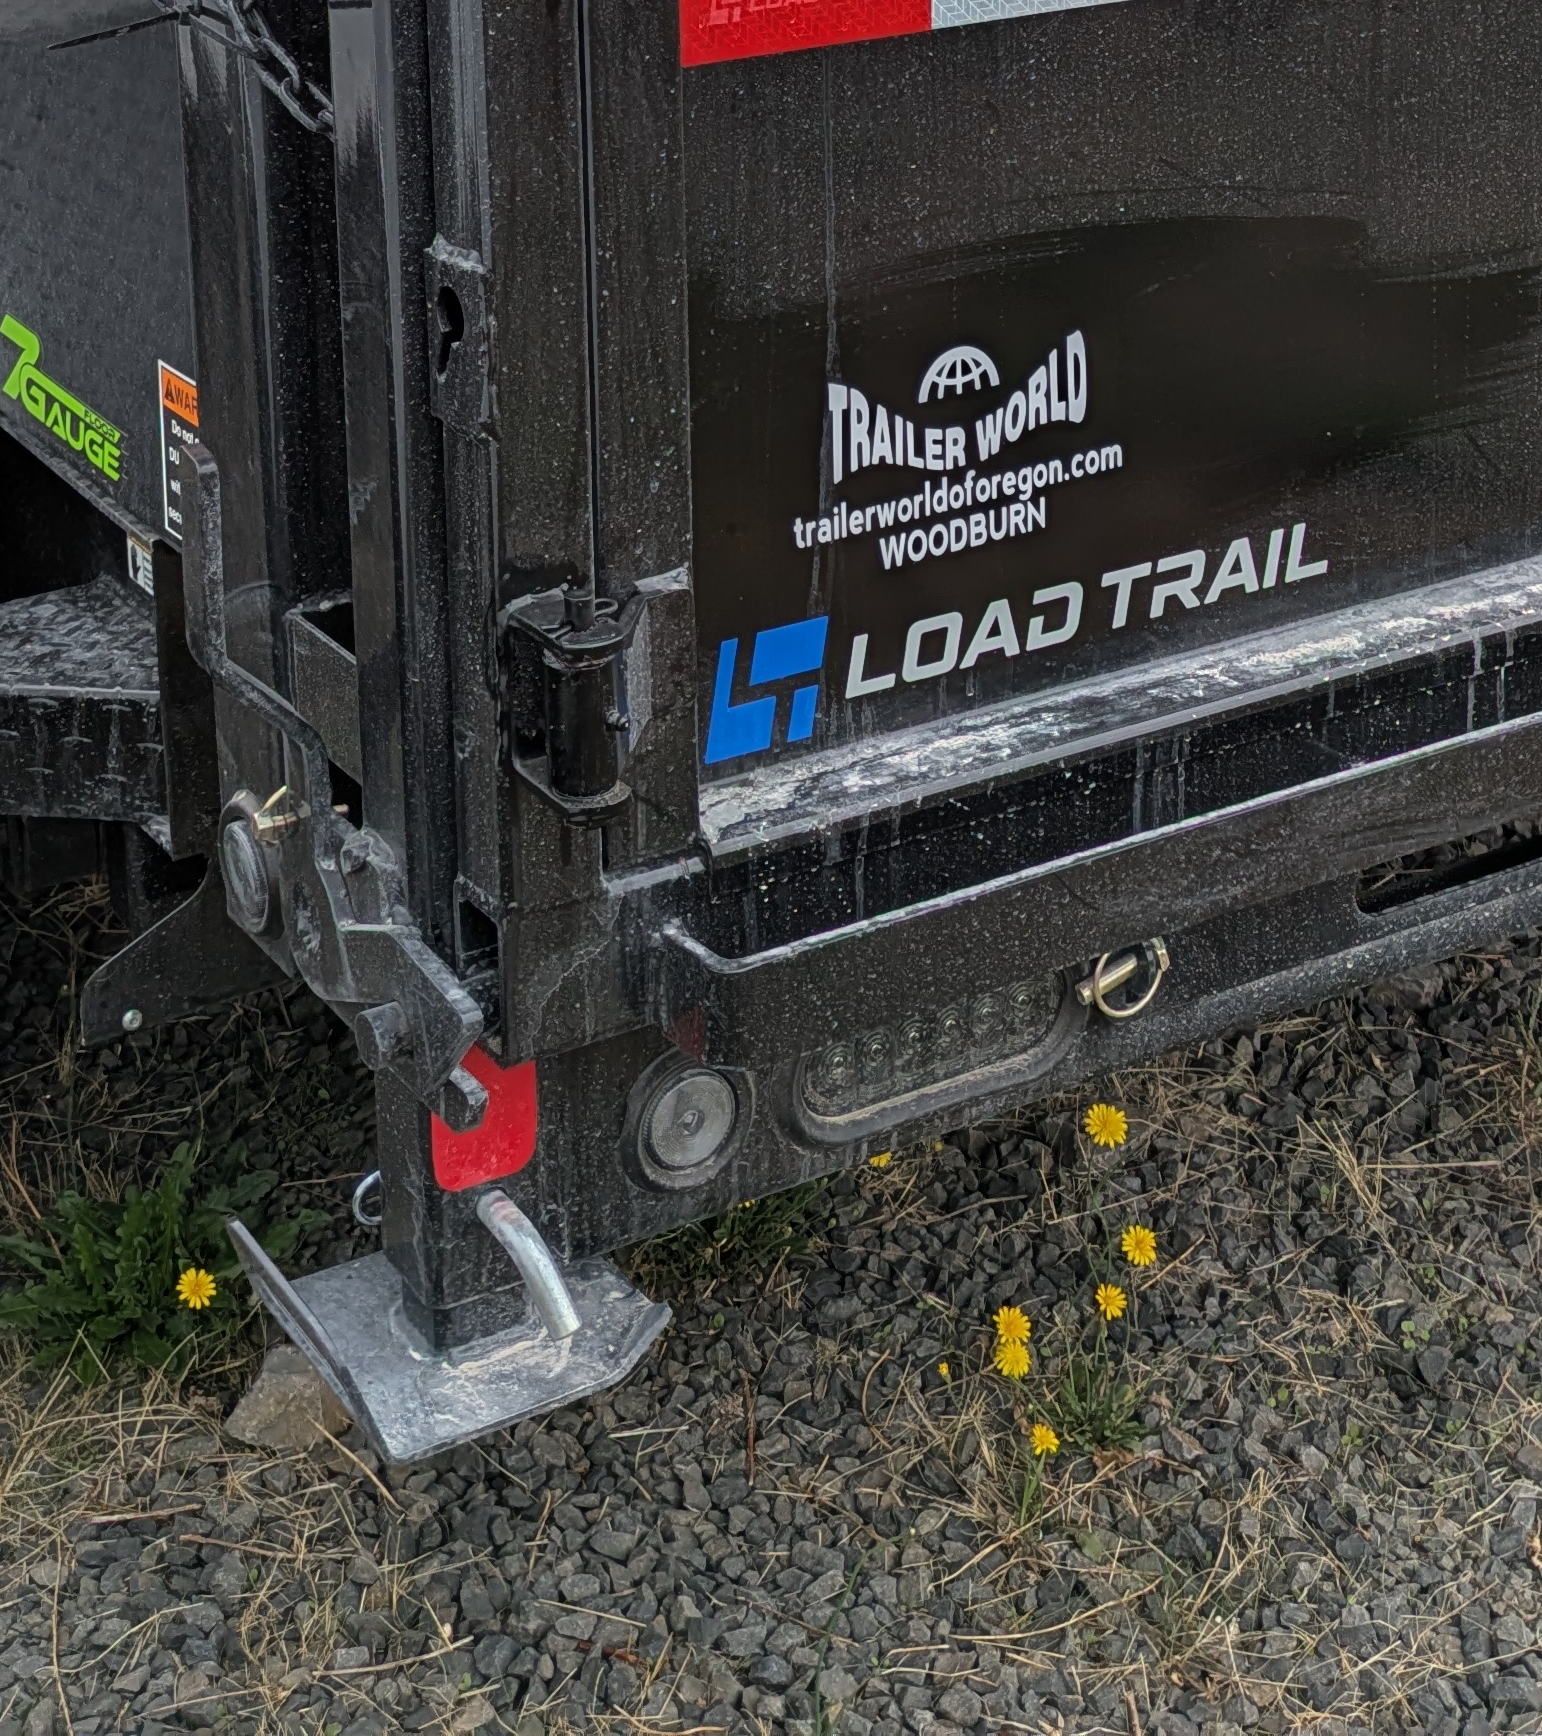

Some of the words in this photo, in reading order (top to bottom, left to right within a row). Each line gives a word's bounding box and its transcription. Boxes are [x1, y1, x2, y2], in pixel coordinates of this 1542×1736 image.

[0, 313, 43, 401] 7
[828, 382, 967, 485] TRAILER
[974, 329, 1089, 461] WORLD
[20, 363, 121, 482] GAUGE
[794, 443, 1124, 550] trailerworldoforegon.com
[879, 496, 1048, 571] WOODBURN
[844, 580, 1084, 700] LOAD
[1100, 522, 1329, 630] TRAIL
